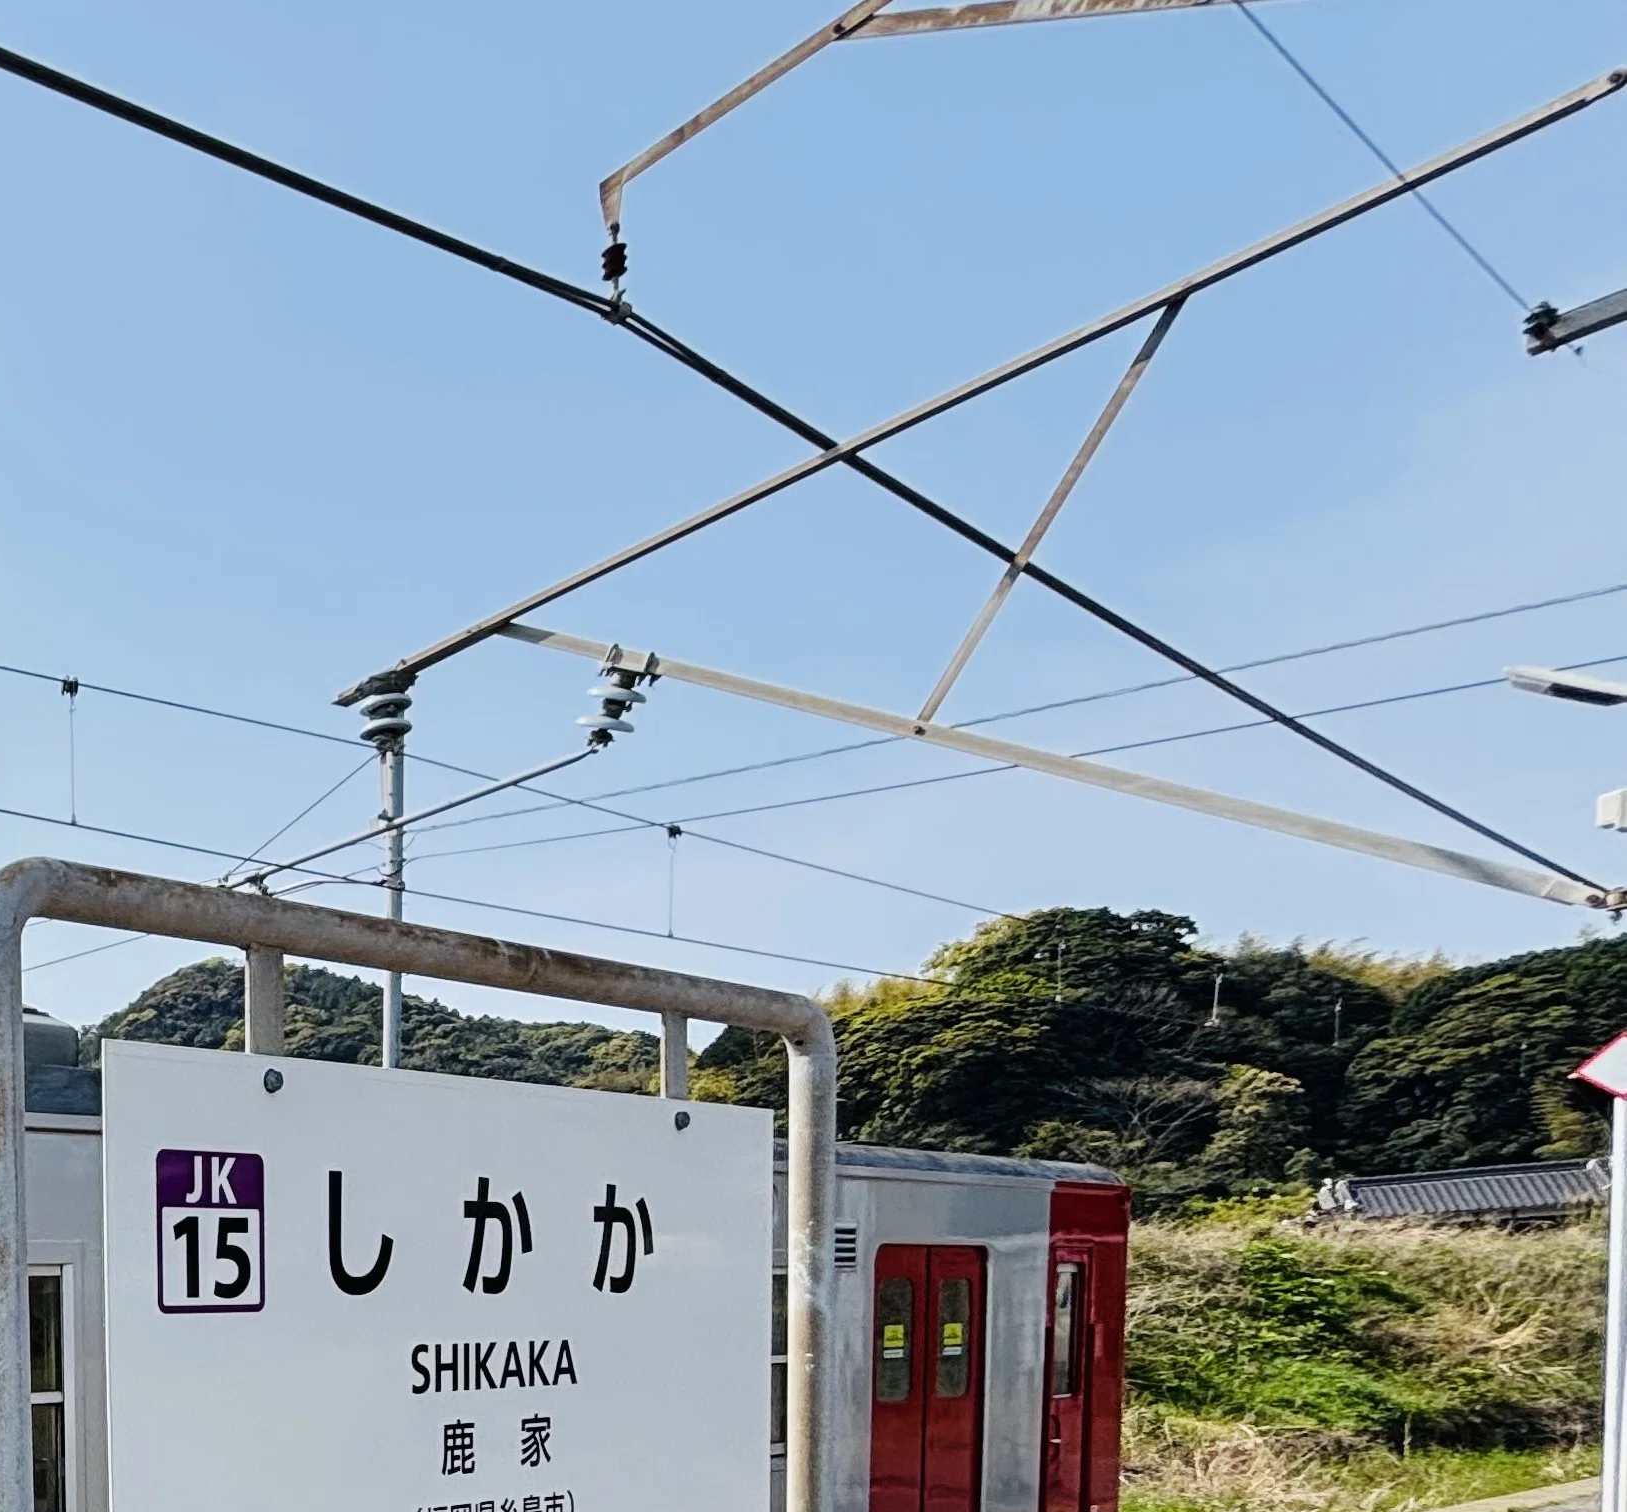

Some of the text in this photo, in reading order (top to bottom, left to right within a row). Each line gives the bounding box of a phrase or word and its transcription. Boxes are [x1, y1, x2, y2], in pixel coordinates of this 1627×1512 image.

[185, 1155, 237, 1204] JK
[172, 1215, 252, 1299] 15
[328, 1170, 654, 1295] しかか
[411, 1339, 578, 1394] SHIKAKA
[441, 1413, 553, 1475] 鹿家
